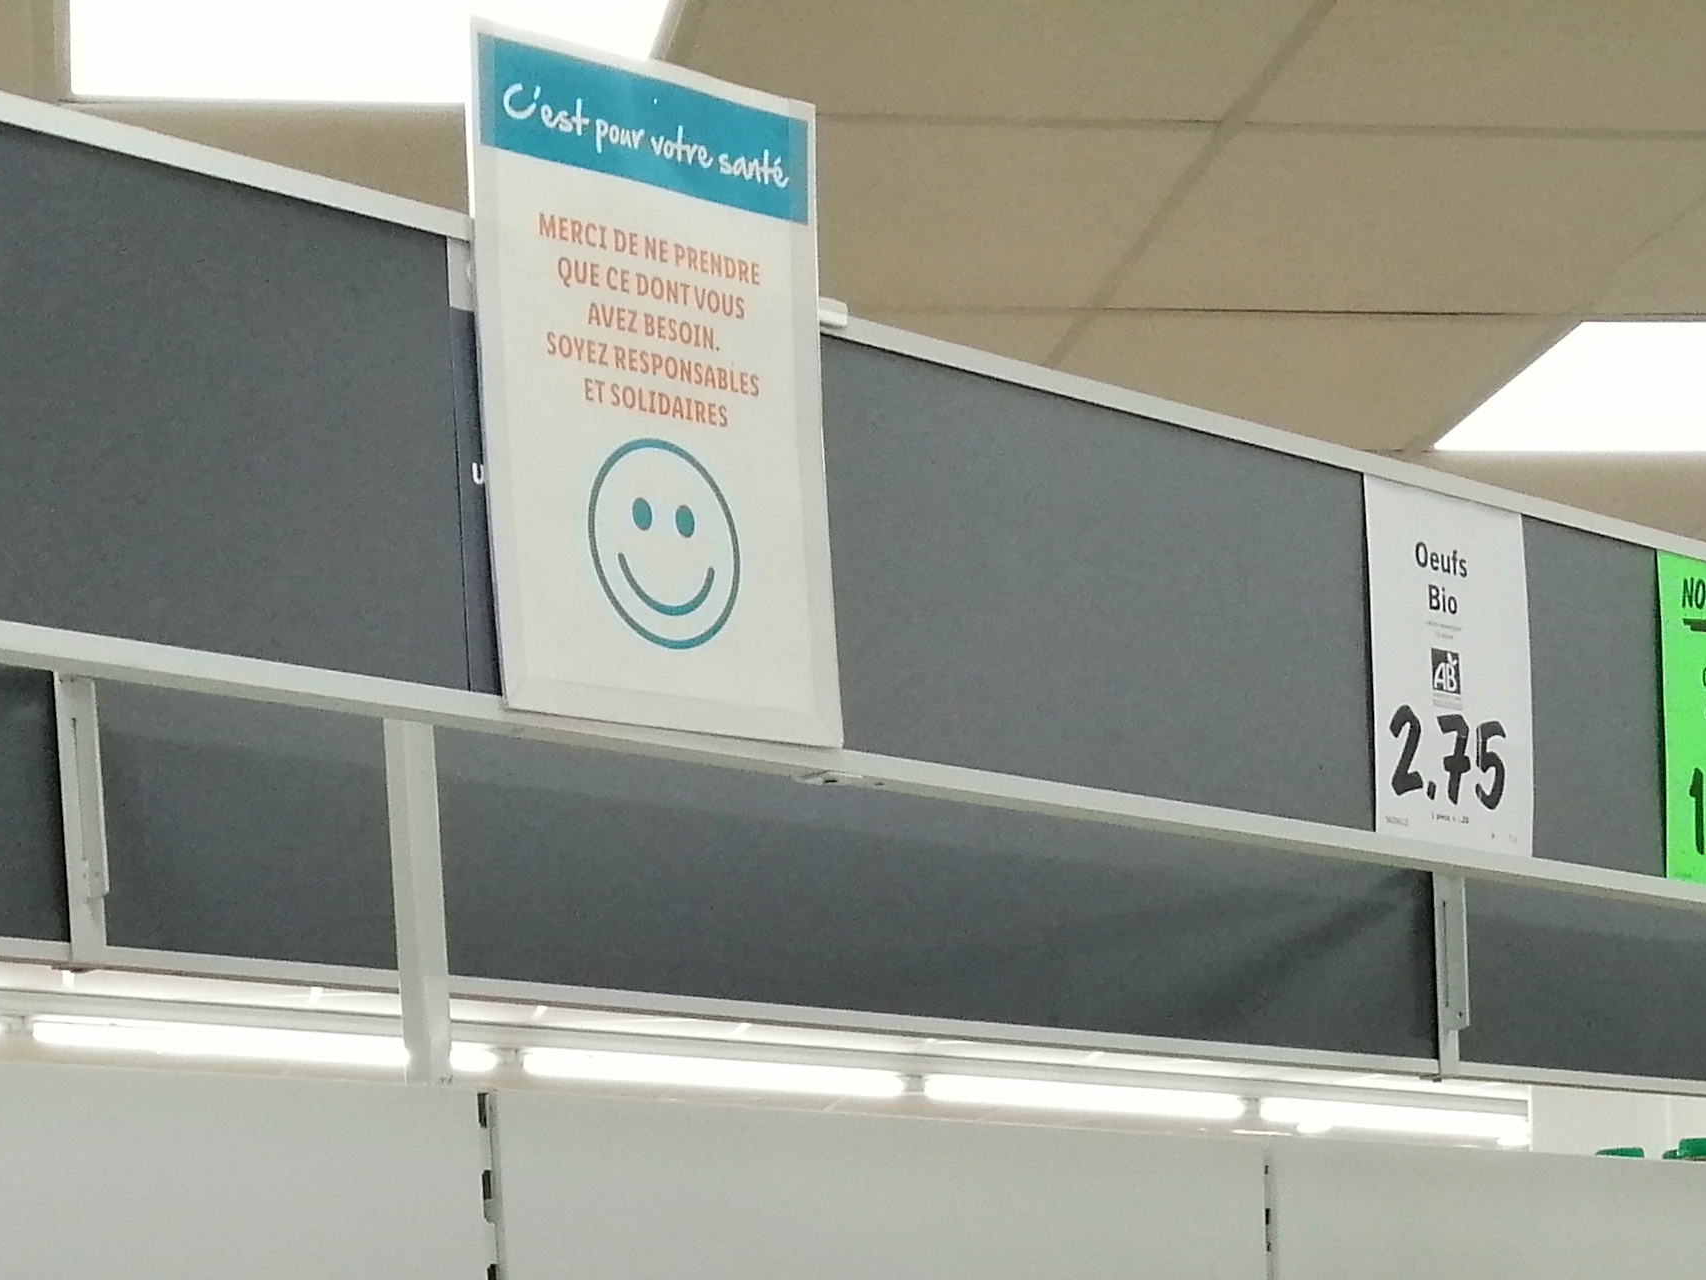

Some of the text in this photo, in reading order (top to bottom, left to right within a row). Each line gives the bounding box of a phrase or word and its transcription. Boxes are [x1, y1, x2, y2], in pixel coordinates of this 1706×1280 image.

[503, 83, 789, 189] C'est pour votre santé
[539, 212, 760, 285] MERCI DE NE PRENDRE
[557, 257, 746, 319] QUE CE DONT VOUS
[587, 302, 720, 352] AVEZ BESOIN.
[546, 332, 760, 397] SOYEZ RESPONSABLES
[584, 378, 729, 428] ET SOLIDAIRES
[1415, 541, 1468, 578] Oeufs
[1428, 584, 1458, 615] Bio
[1434, 660, 1458, 692] AB
[1389, 705, 1506, 810] 2.75
